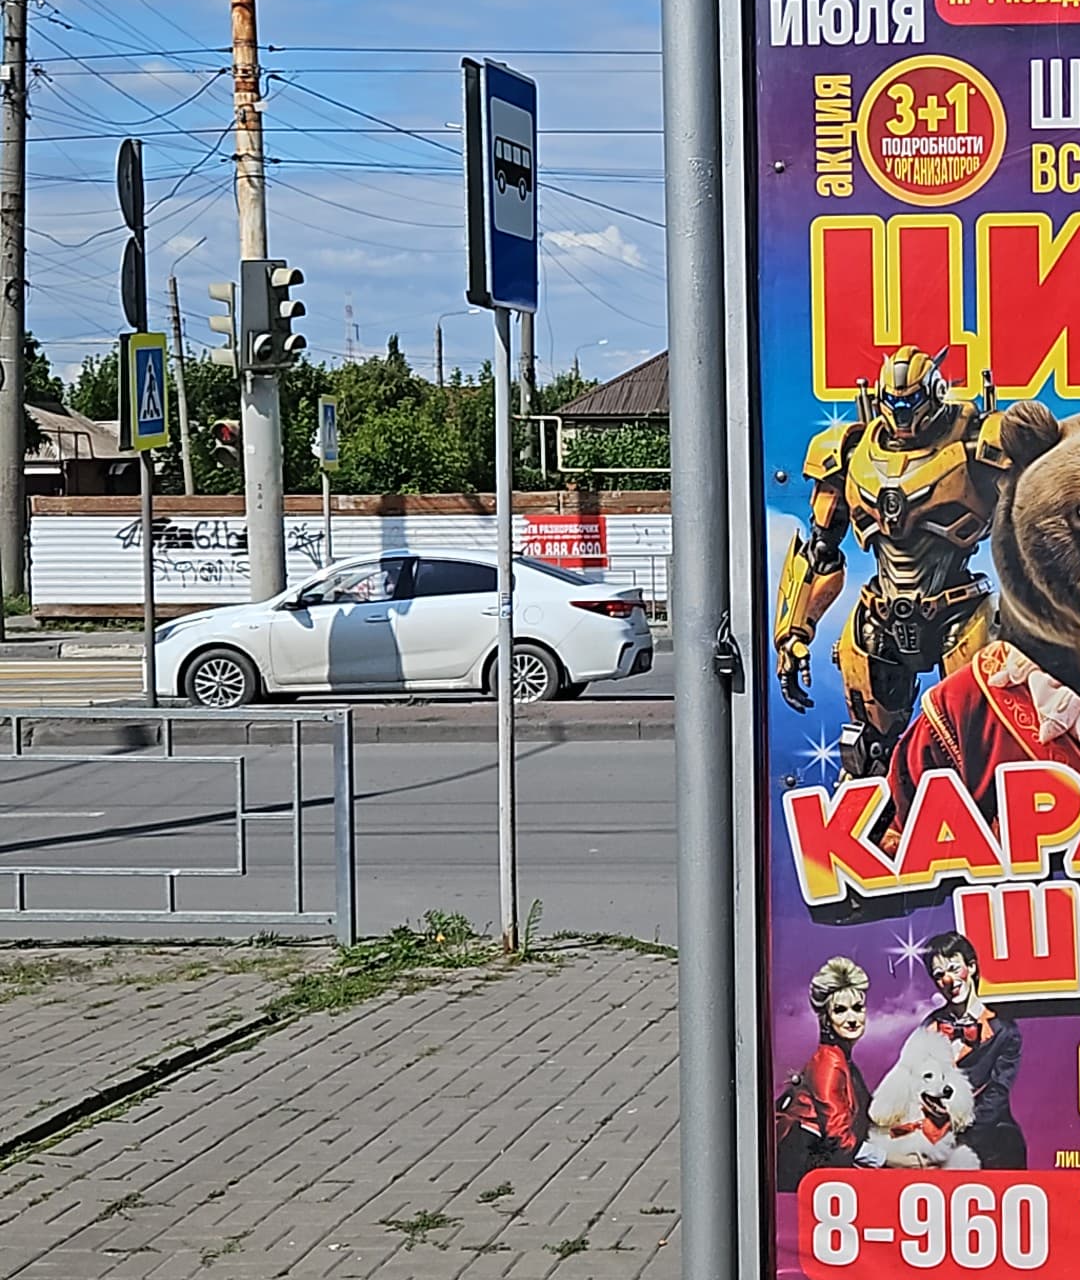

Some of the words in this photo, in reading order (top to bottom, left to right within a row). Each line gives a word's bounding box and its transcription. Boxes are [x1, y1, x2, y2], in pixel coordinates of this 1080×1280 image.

[881, 136, 984, 157] ПОДРОБНОСТИ
[884, 158, 893, 173] У
[894, 156, 981, 186] ОРГАНИЗАТОРОВ
[809, 1180, 1050, 1271] 8-960
